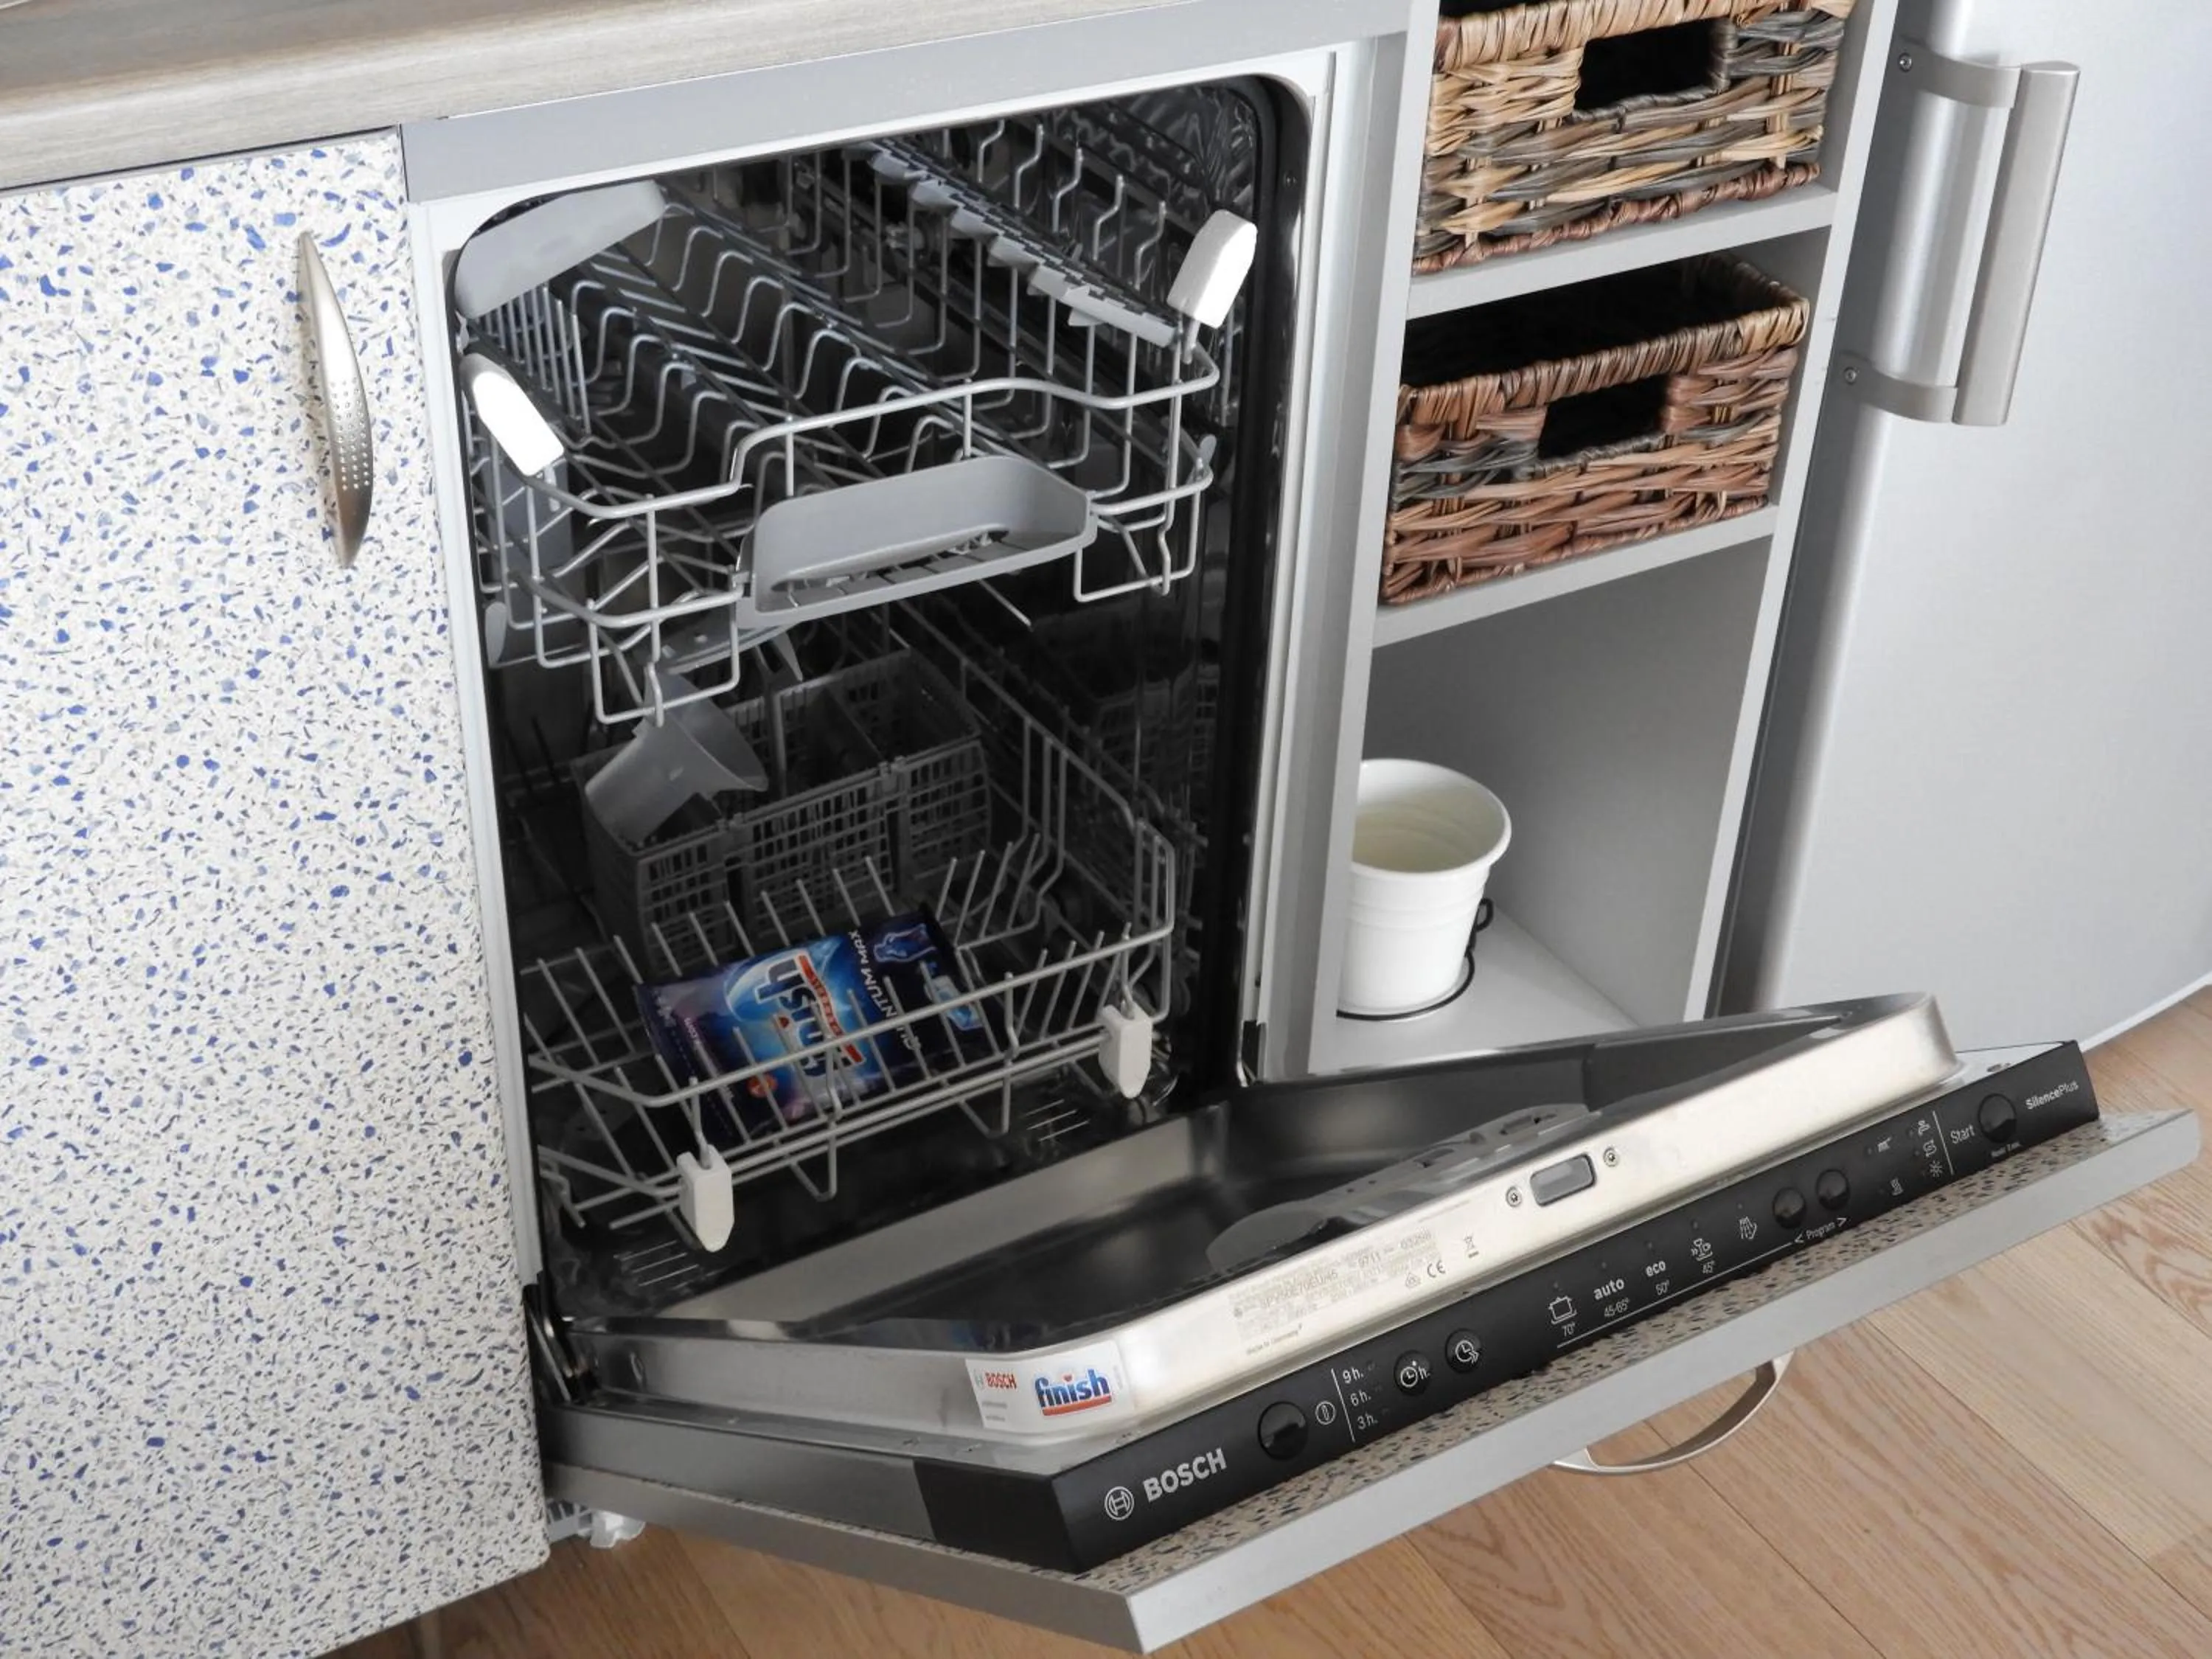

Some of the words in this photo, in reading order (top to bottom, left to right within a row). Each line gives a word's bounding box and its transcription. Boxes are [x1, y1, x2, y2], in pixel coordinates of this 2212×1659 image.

[861, 968, 916, 1050] QUNTUM
[2025, 1080, 2079, 1110] SilencePlus
[1950, 1124, 1975, 1144] Start
[1806, 1221, 1836, 1241] Program
[1646, 1261, 1666, 1277] eco
[1593, 1278, 1625, 1301] auto
[984, 1372, 1018, 1391] BOSCH
[1034, 1368, 1110, 1408] finish
[1142, 1447, 1228, 1503] BOSCH
